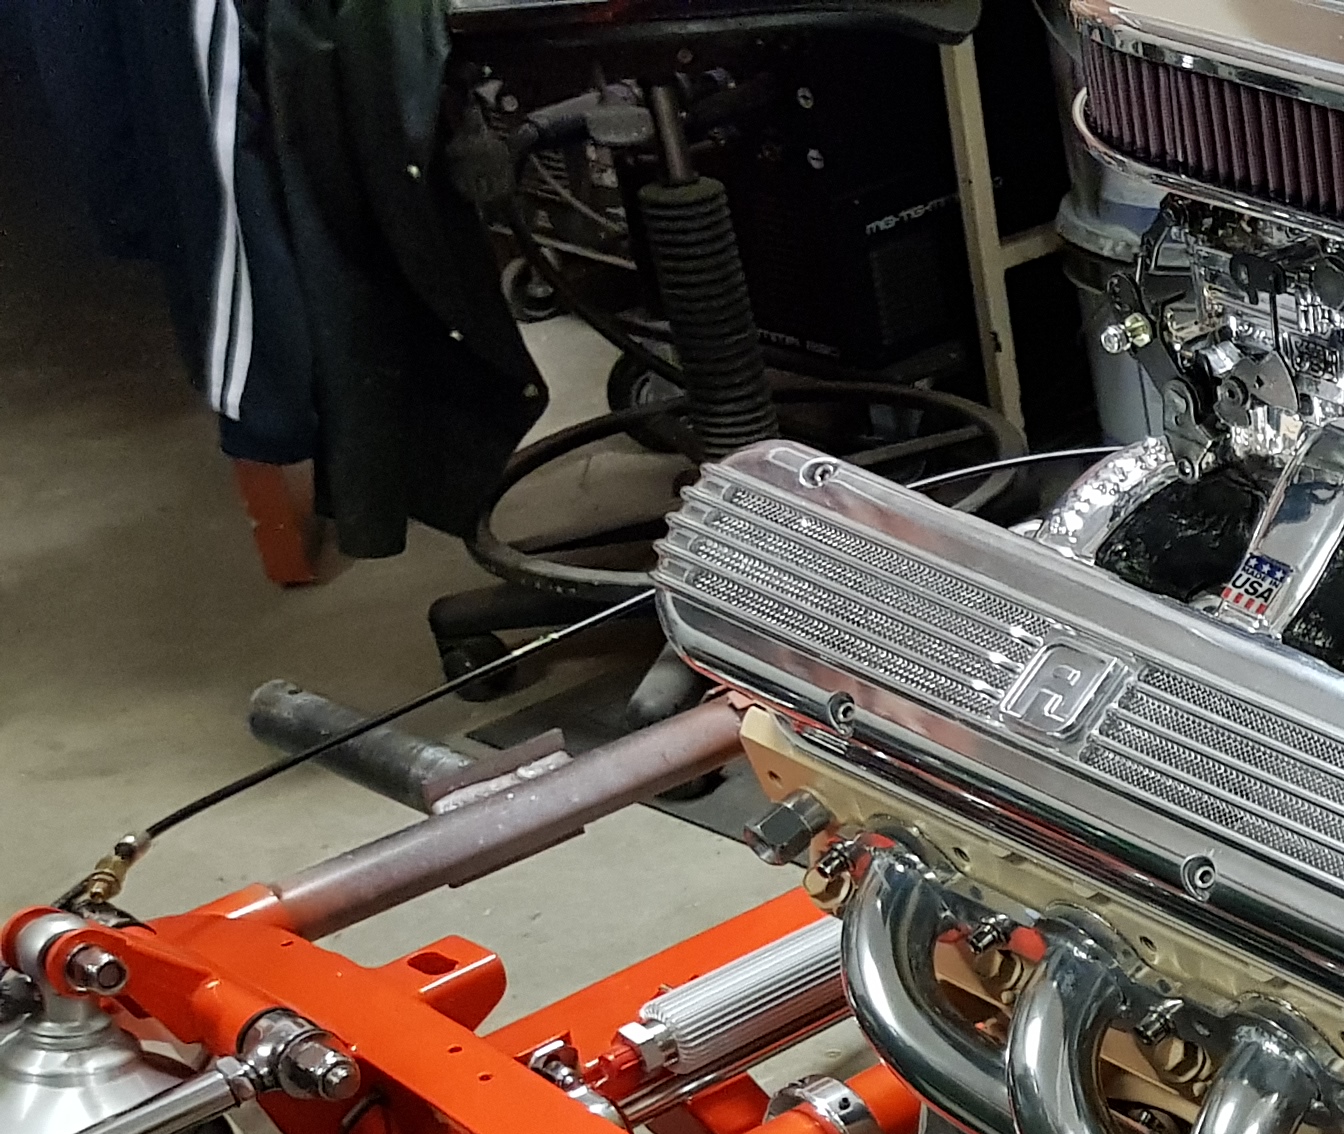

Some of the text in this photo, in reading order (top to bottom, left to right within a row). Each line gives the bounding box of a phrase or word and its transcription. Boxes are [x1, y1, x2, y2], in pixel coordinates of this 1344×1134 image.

[1231, 573, 1274, 603] USA
[1241, 565, 1280, 589] MADE IN
